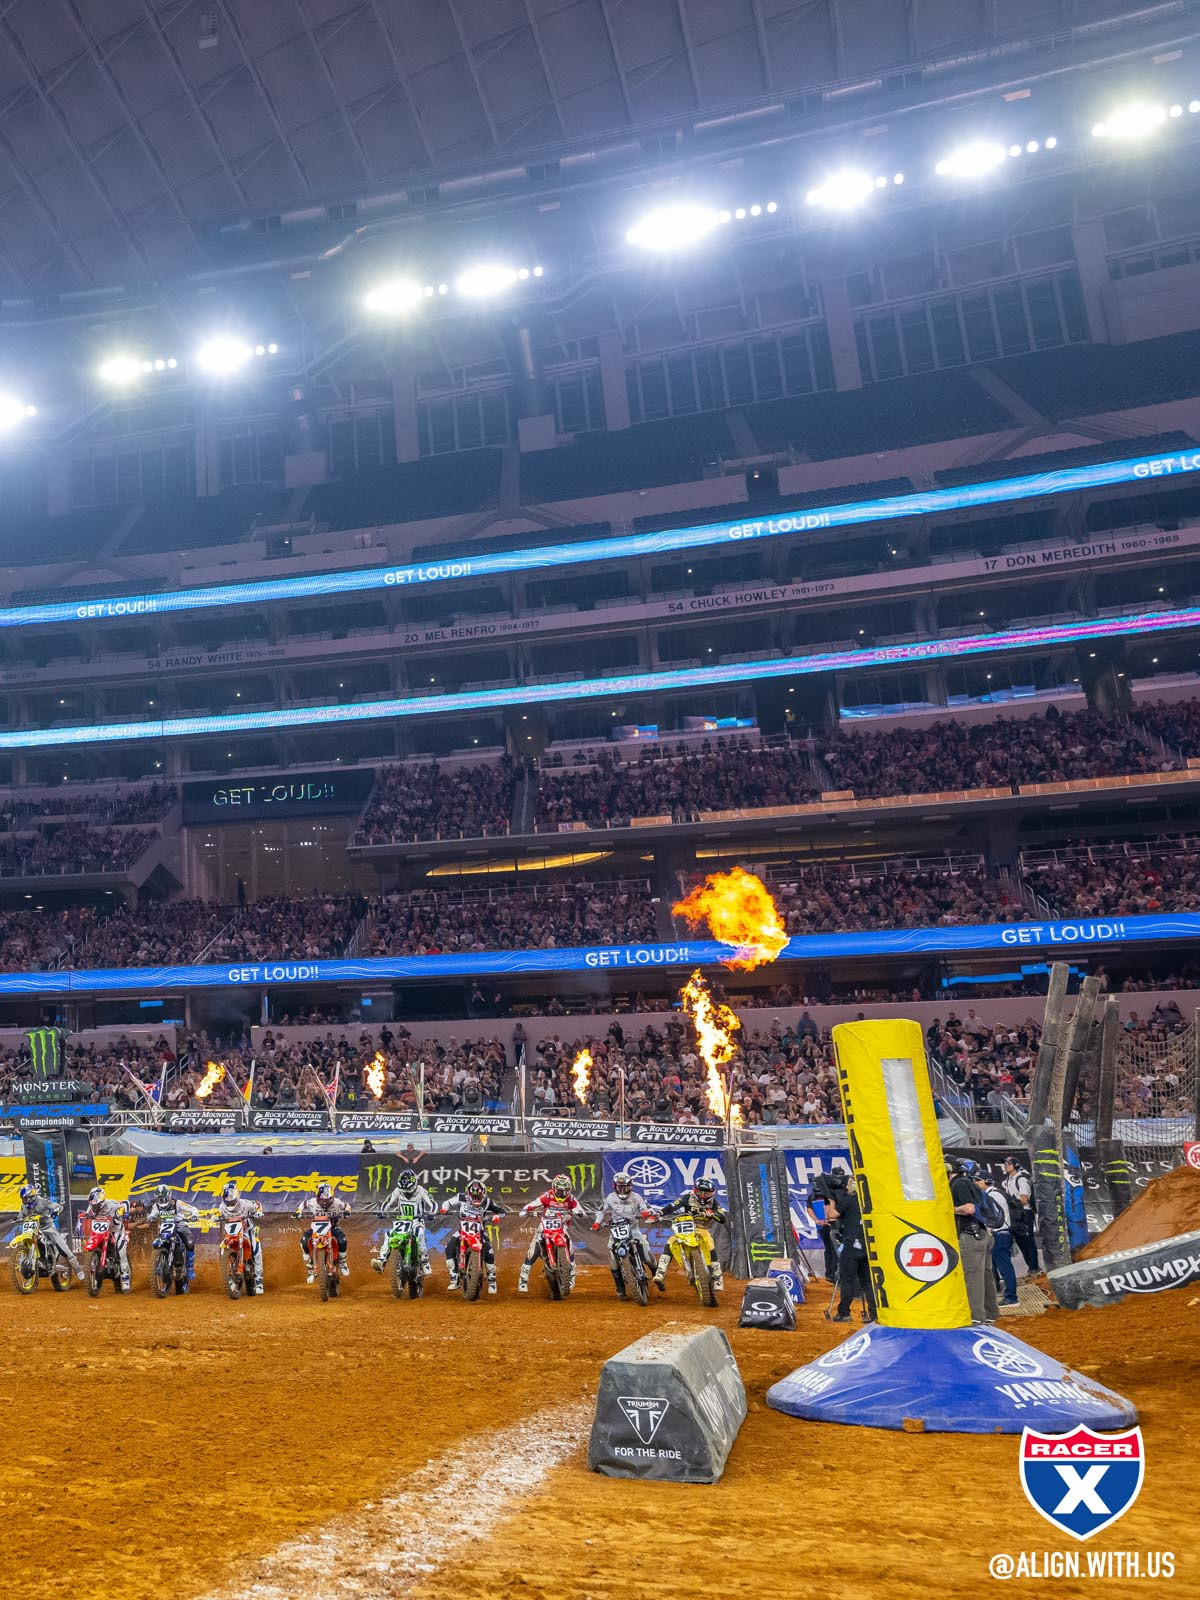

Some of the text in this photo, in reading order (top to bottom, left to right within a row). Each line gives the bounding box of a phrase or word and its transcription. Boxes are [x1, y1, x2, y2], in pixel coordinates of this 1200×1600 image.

[1133, 457, 1175, 477] GET
[729, 513, 830, 539] GET LOUD!!
[983, 558, 999, 570] 17
[1006, 554, 1037, 568] DON
[1042, 543, 1117, 562] MEREDITH
[383, 563, 471, 585] GET LOUD!!
[76, 600, 156, 618] GET LOUD!!
[668, 603, 684, 612] 54
[690, 596, 731, 610] CHUCK
[735, 588, 787, 604] HOWLEY
[404, 633, 419, 643] 20
[425, 629, 449, 641] MEL
[451, 624, 497, 639] RENFRO
[166, 654, 202, 668] RANDY
[207, 649, 242, 662] WHITE
[213, 787, 255, 806] GET
[1001, 923, 1126, 944] GET LOUD!!
[585, 948, 688, 966] GET LOUD!!
[228, 966, 319, 982] GET LOUD!!
[12, 1080, 77, 1094] MONSTER
[20, 1118, 75, 1128] Championship
[568, 1121, 609, 1130] MOUNTAIN
[649, 1125, 717, 1135] ROCKY MOUNTAIN
[32, 1162, 41, 1196] NSTER
[417, 1165, 554, 1185] MONSTER
[673, 1156, 853, 1185] YAHA
[834, 1041, 889, 1310] LEADER
[191, 1171, 359, 1197] alpinestars
[746, 1181, 757, 1224] MONSTER
[770, 1180, 780, 1227] CHAMPIONSHIP
[23, 1222, 36, 1231] 94
[92, 1222, 108, 1233] 96
[161, 1223, 174, 1233] 2
[230, 1223, 238, 1233] 1
[315, 1222, 329, 1233] 7
[394, 1222, 411, 1232] 21
[462, 1222, 478, 1233] 14
[545, 1220, 561, 1229] 55
[613, 1226, 628, 1237] 15
[675, 1222, 695, 1234] 12
[905, 1249, 944, 1269] D
[1093, 1254, 1200, 1295] TRIUMPH
[745, 1310, 784, 1318] OAKLEY
[994, 1381, 1101, 1403] YAMAHA
[626, 1400, 659, 1409] TRIUMPH
[615, 1447, 682, 1460] FOR THE RIDE
